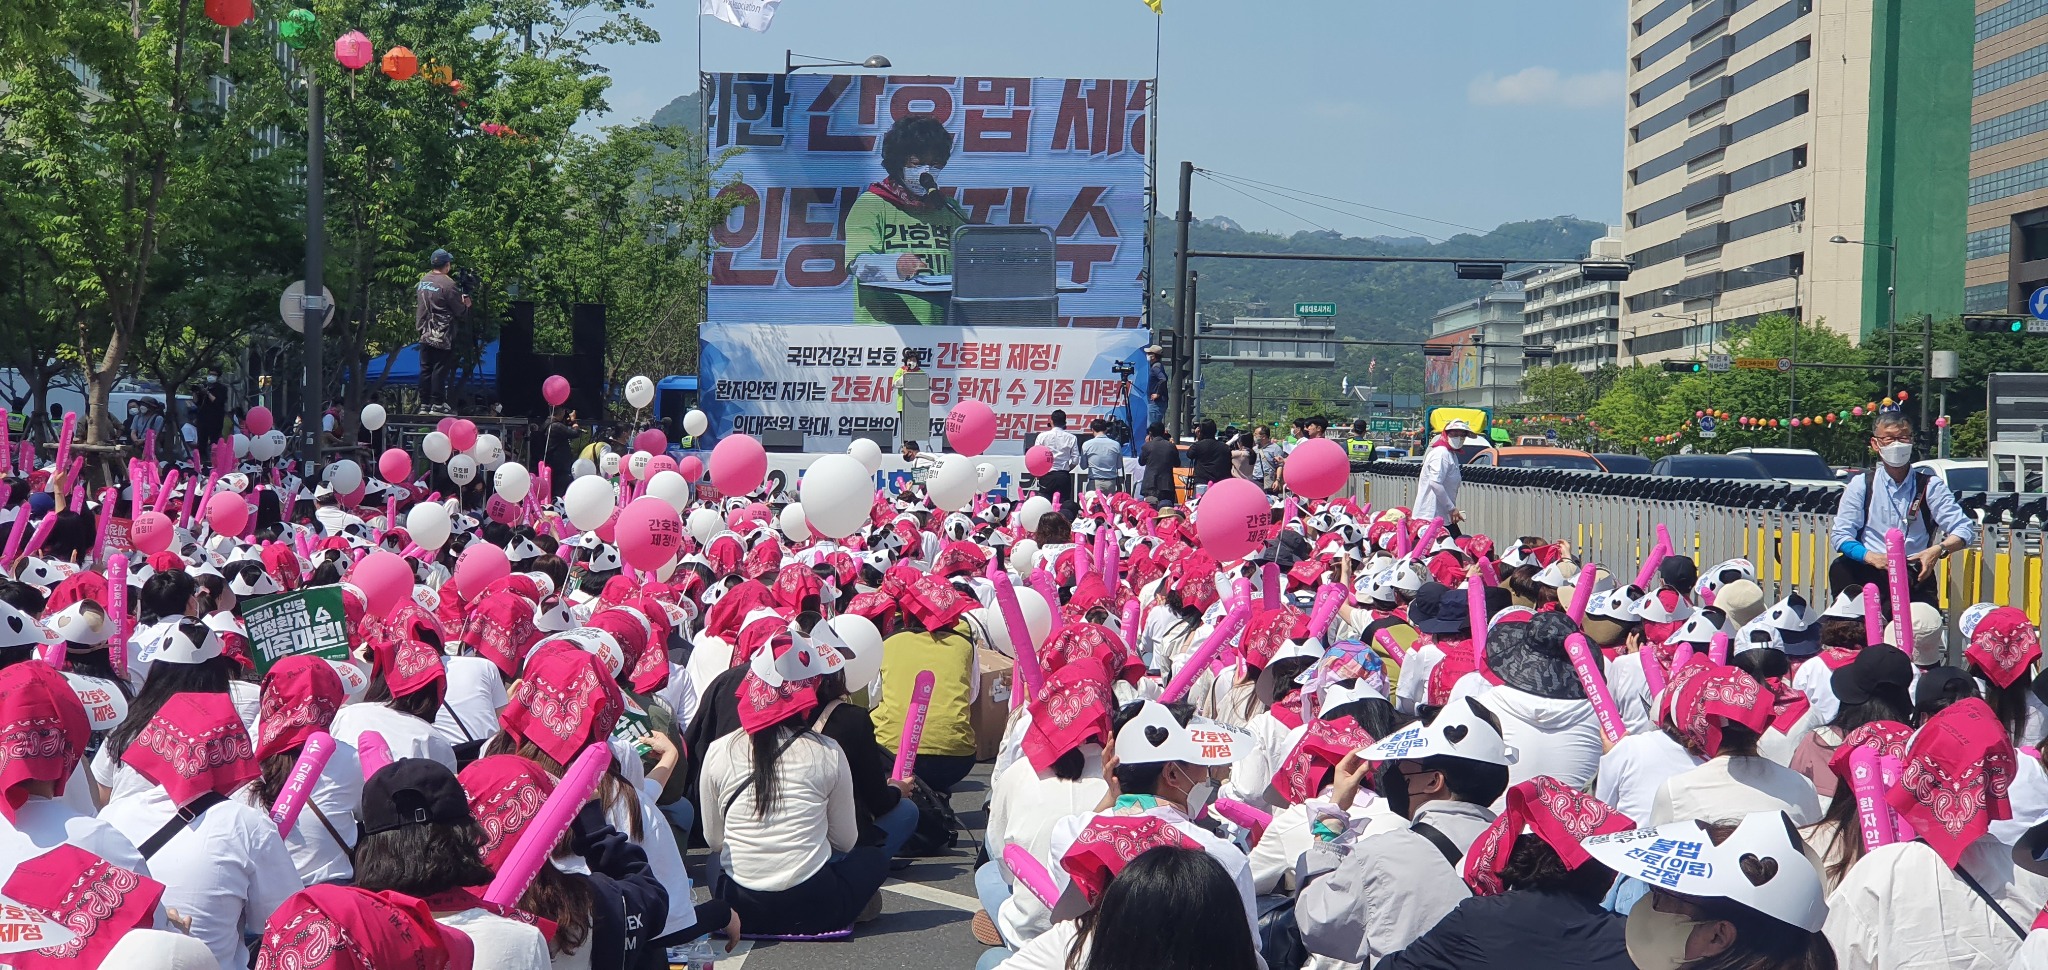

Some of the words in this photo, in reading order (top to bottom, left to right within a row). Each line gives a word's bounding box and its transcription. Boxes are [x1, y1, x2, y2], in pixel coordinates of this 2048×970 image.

[787, 346, 863, 367] 국민건강권
[866, 346, 898, 367] 보호
[937, 342, 1002, 370] 간호법
[1006, 343, 1062, 371] 제정!
[716, 379, 777, 401] 환자안전
[780, 381, 826, 401] 지키는
[830, 375, 895, 404] 간호사
[957, 377, 1002, 405] 환자
[1006, 378, 1027, 406] 수
[1031, 378, 1075, 406] 기준
[648, 518, 680, 533] 간호법
[650, 533, 677, 547] 제정!!
[1888, 559, 1898, 585] 간호사
[113, 583, 122, 608] 간호사
[1890, 586, 1900, 612] 1인당
[246, 607, 274, 626] 간호사
[275, 598, 306, 615] 1인당
[249, 610, 311, 642] 적정환자
[315, 606, 332, 623] 수
[256, 621, 345, 662] 기준마련!
[77, 687, 112, 705] 간호법
[92, 704, 117, 723] 제정
[1190, 729, 1234, 744] 간호법
[1200, 744, 1232, 759] 제정
[289, 762, 312, 792] 간호사
[1650, 836, 1704, 862] 불법
[1623, 846, 1713, 879] 진료(의료)
[1640, 864, 1684, 888] 근절
[0, 902, 47, 924] 호법
[625, 912, 644, 931] EX
